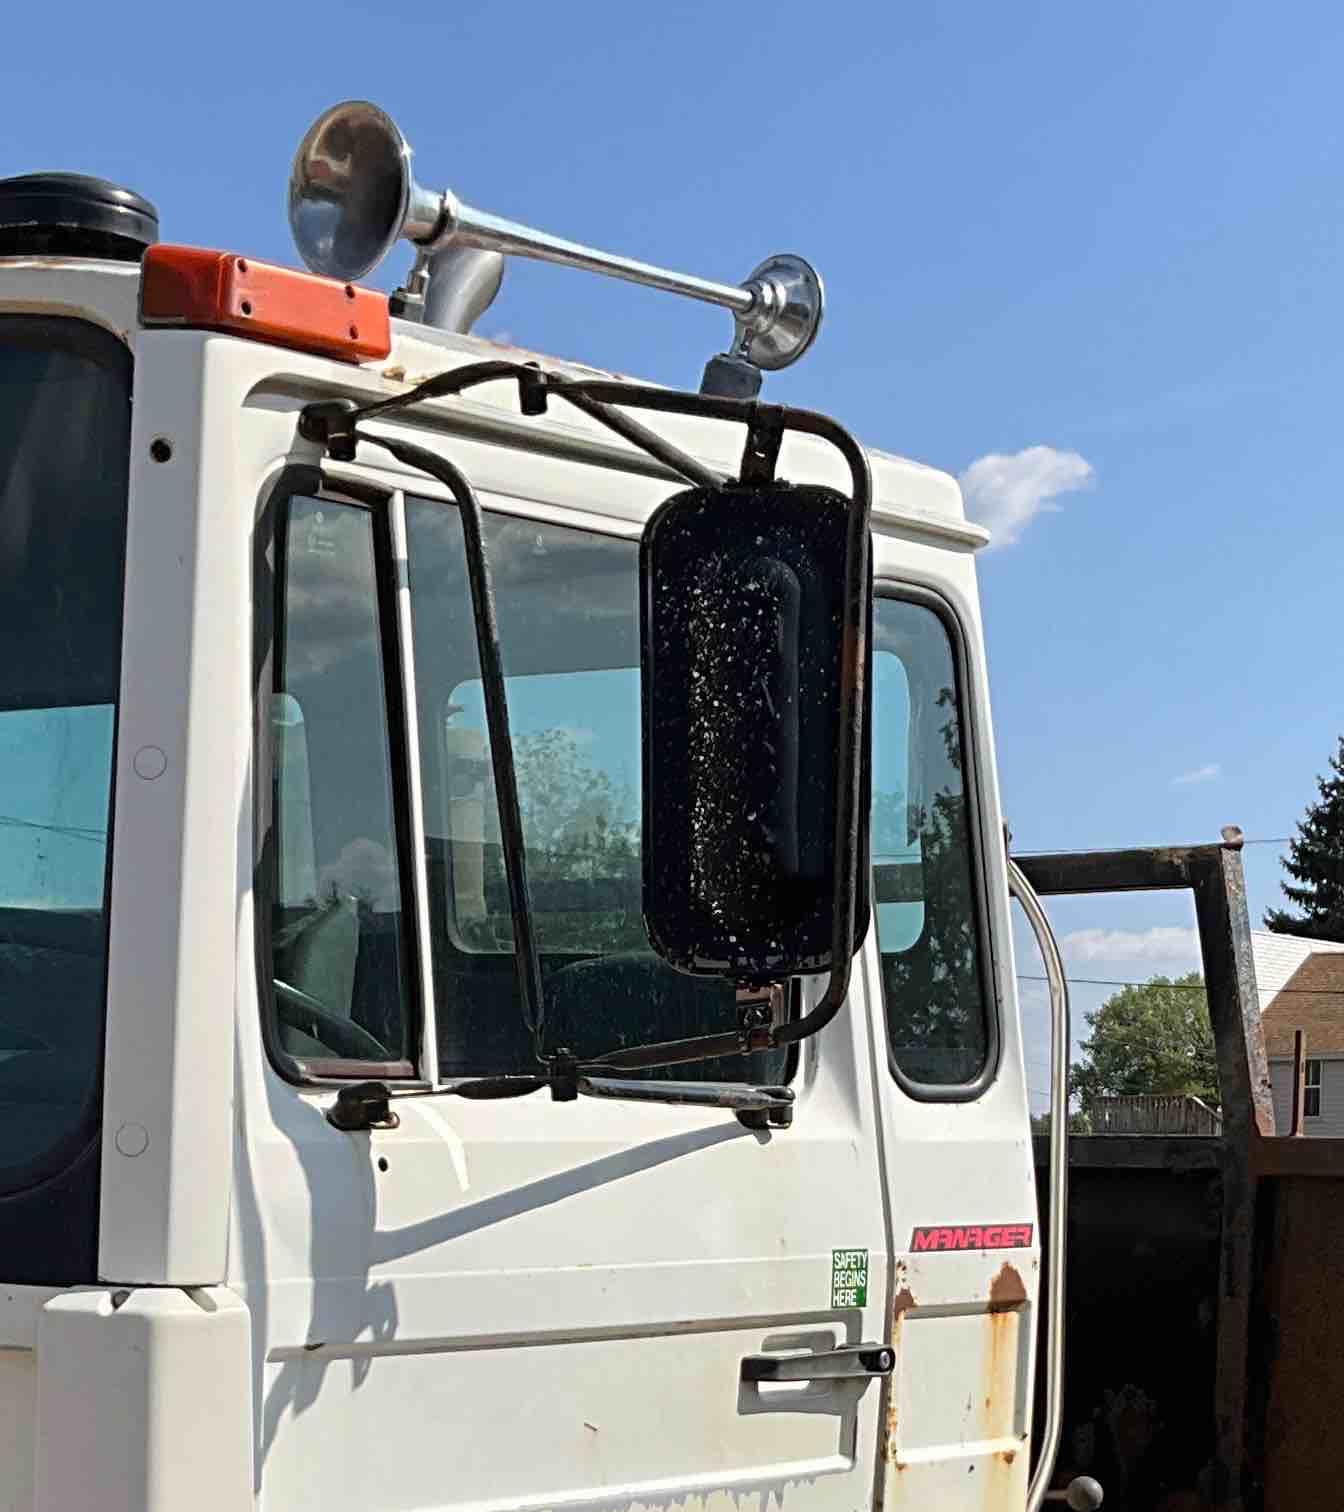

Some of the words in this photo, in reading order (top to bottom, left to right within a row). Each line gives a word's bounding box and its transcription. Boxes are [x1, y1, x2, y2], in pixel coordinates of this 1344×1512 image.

[912, 1226, 1031, 1250] MANAGER
[834, 1251, 867, 1269] SAFETY
[833, 1269, 866, 1287] BEGINS
[832, 1288, 857, 1306] HERE
